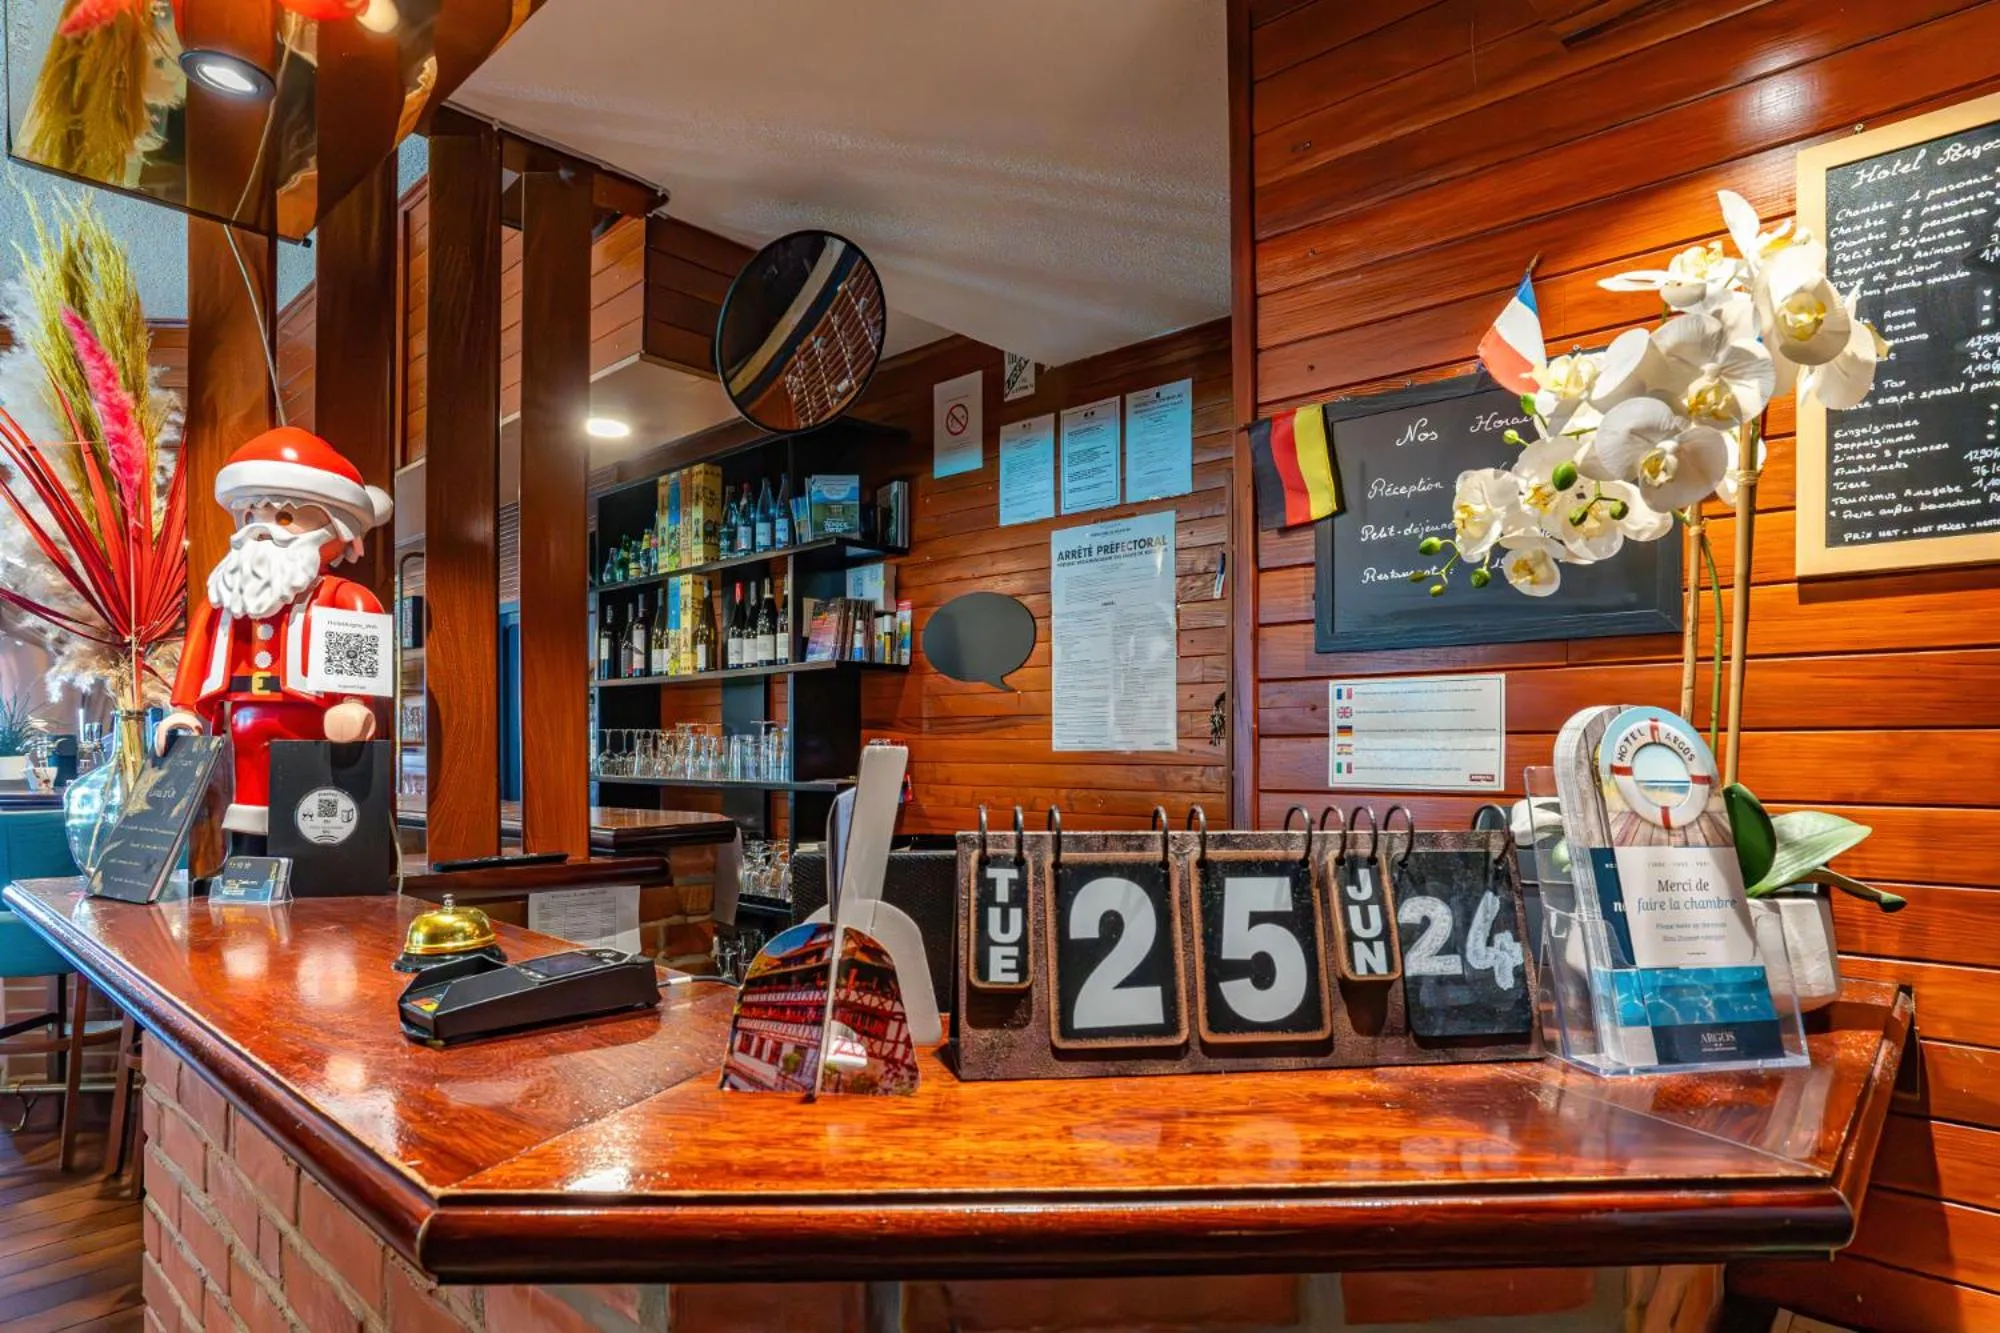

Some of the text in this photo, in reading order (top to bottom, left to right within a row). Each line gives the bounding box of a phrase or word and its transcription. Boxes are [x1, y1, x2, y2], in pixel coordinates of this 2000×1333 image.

[1851, 149, 1927, 189] Hotel
[1830, 218, 1888, 238] Chambre
[1883, 307, 1917, 319] Room
[1396, 418, 1438, 446] Nos
[1367, 477, 1444, 499] Réception
[1057, 534, 1168, 562] ARRÊTÉ PRÉFECTORAL
[1617, 727, 1696, 762] HOTEL ARGOS
[1657, 878, 1710, 893] Merci de
[1637, 896, 1737, 914] faire la chambre
[986, 868, 1022, 984] TUE
[1346, 869, 1387, 977] JUN
[1397, 889, 1524, 990] 24
